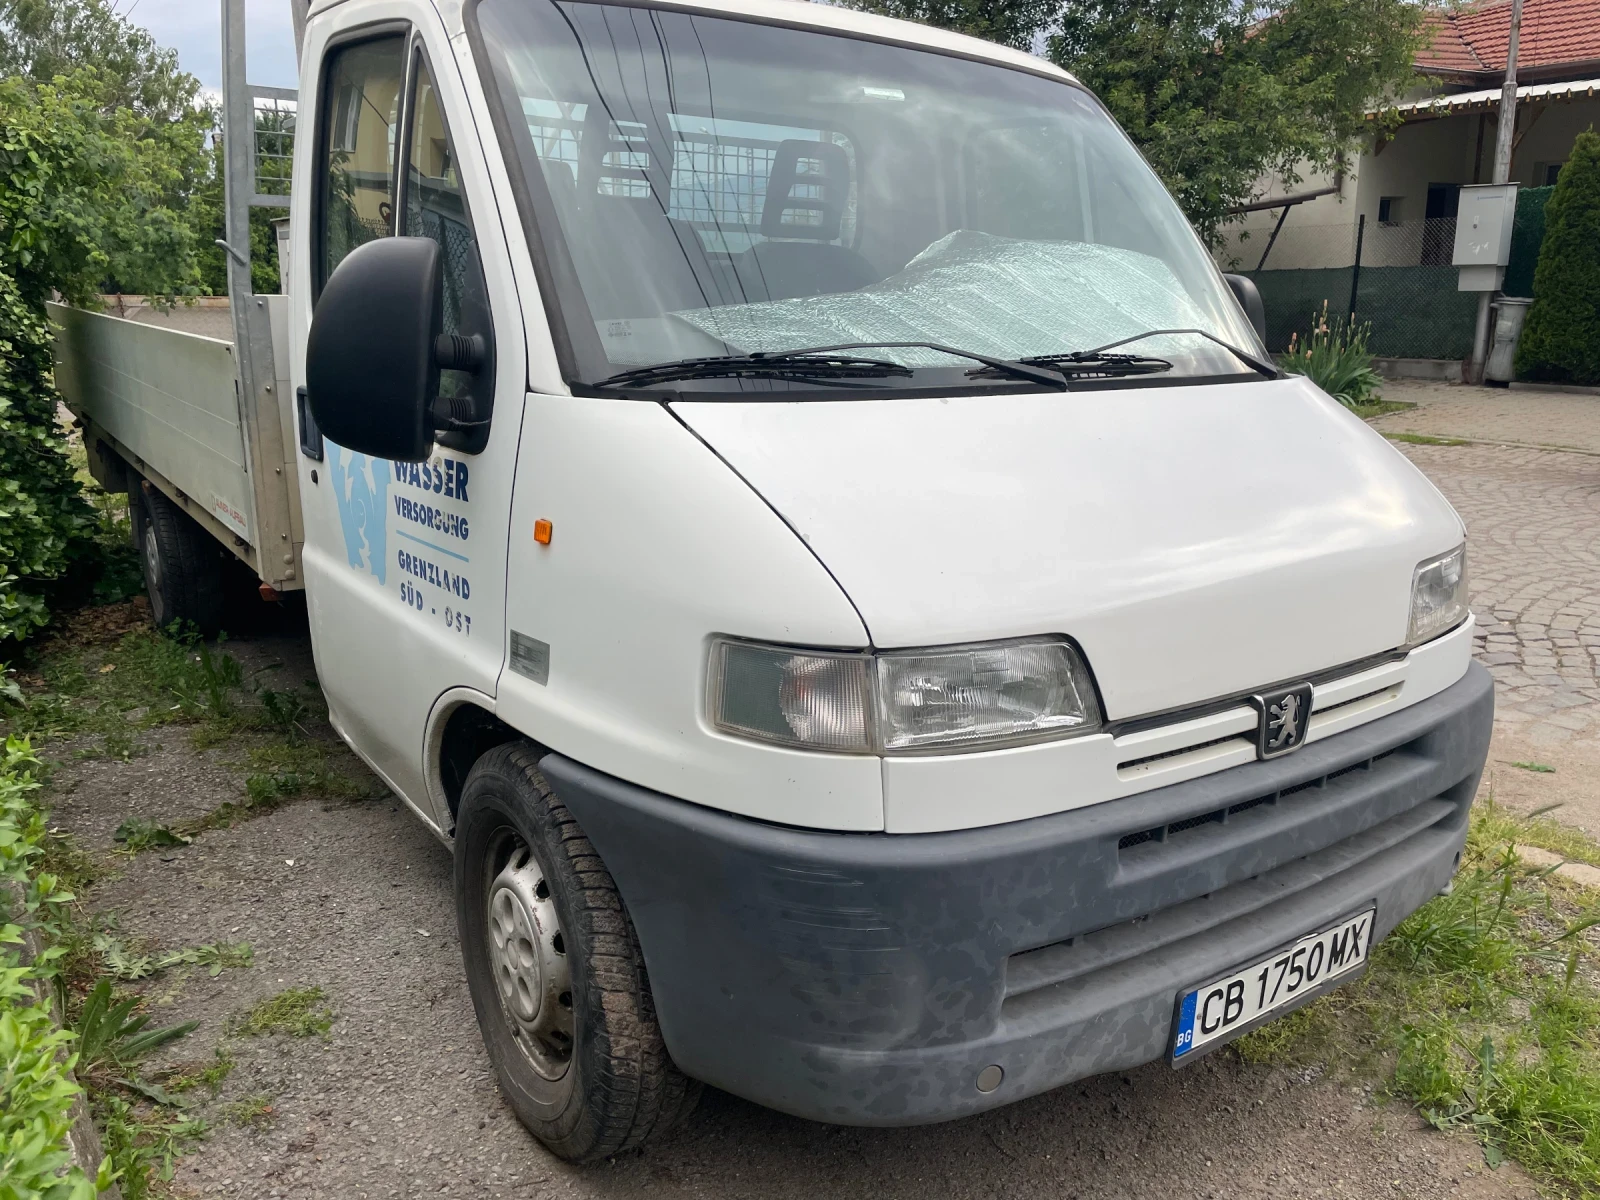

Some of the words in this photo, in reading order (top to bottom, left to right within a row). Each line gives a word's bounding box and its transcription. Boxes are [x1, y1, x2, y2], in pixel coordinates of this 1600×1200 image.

[394, 459, 469, 502] WASSER
[394, 495, 469, 540] VERSORGUNG
[398, 550, 470, 600] GRENZLAND
[400, 580, 424, 611] SÜD
[445, 606, 471, 637] OST
[1201, 979, 1245, 1035] CB
[1258, 941, 1324, 1010] 1750
[1327, 917, 1368, 974] MX
[1177, 1029, 1192, 1048] BG
